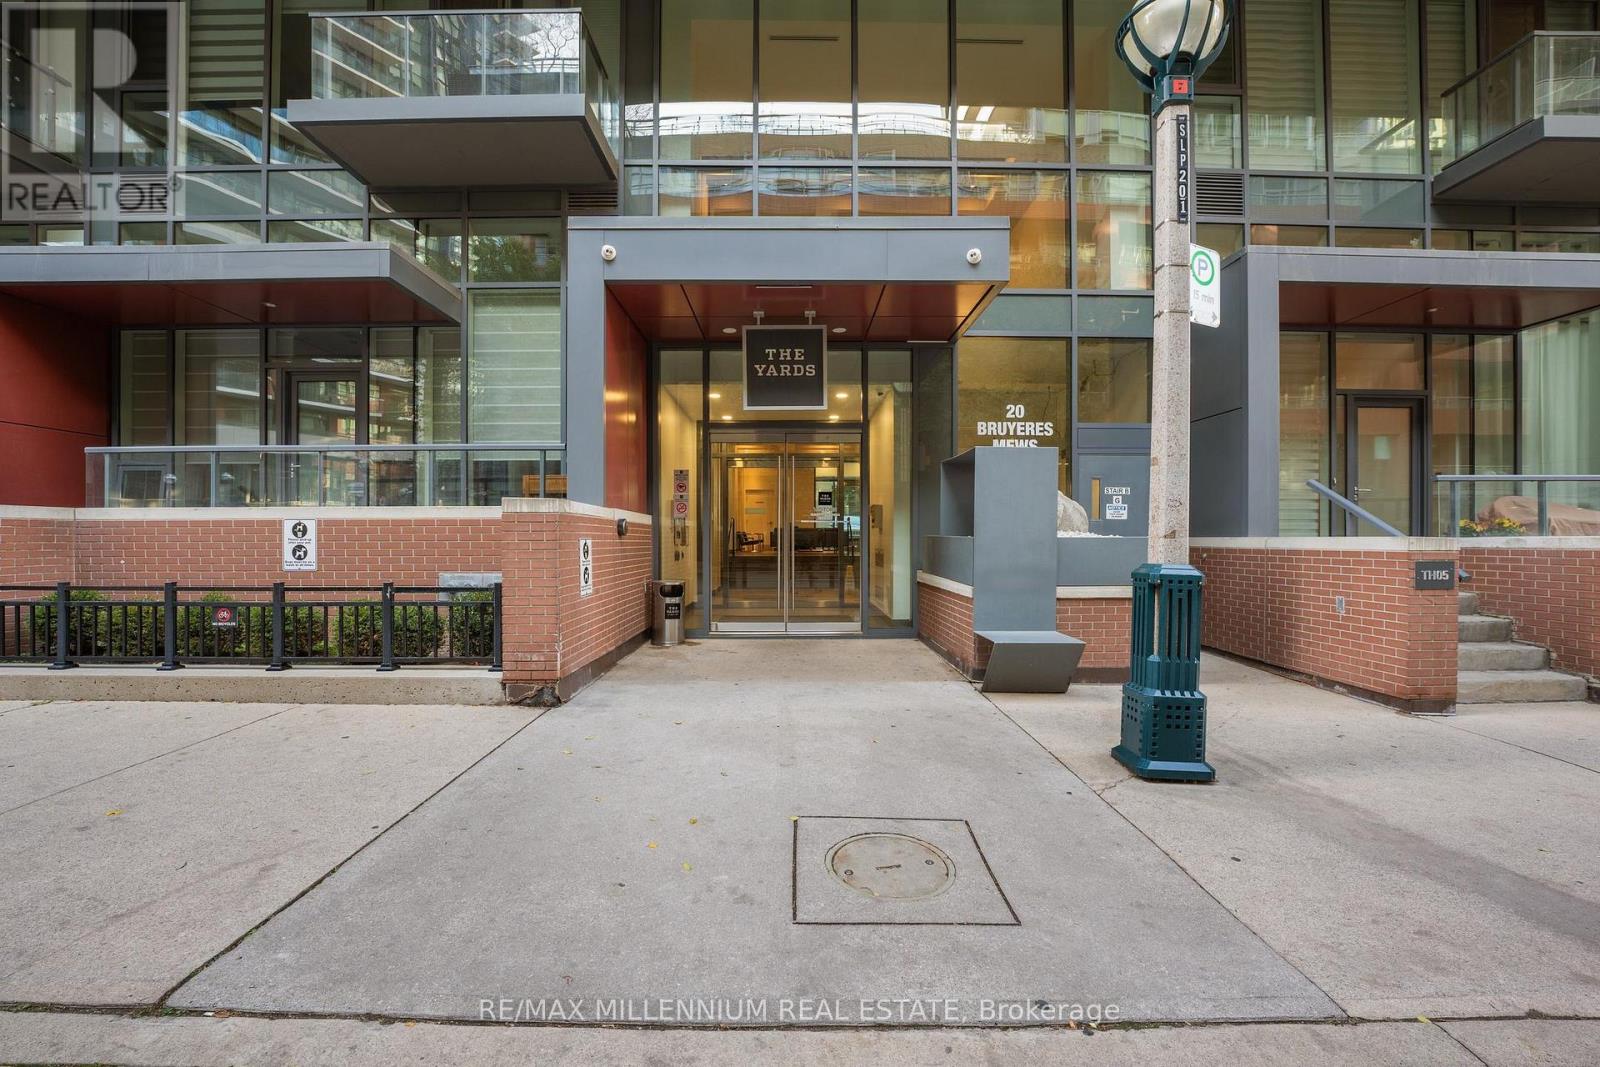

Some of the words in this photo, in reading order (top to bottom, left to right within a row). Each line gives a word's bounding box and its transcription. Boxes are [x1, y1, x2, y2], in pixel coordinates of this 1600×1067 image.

[765, 348, 805, 361] THE
[754, 364, 816, 377] YARDS
[1006, 404, 1025, 418] 20
[977, 421, 1054, 436] BRUYERES
[1421, 570, 1449, 580] TH05
